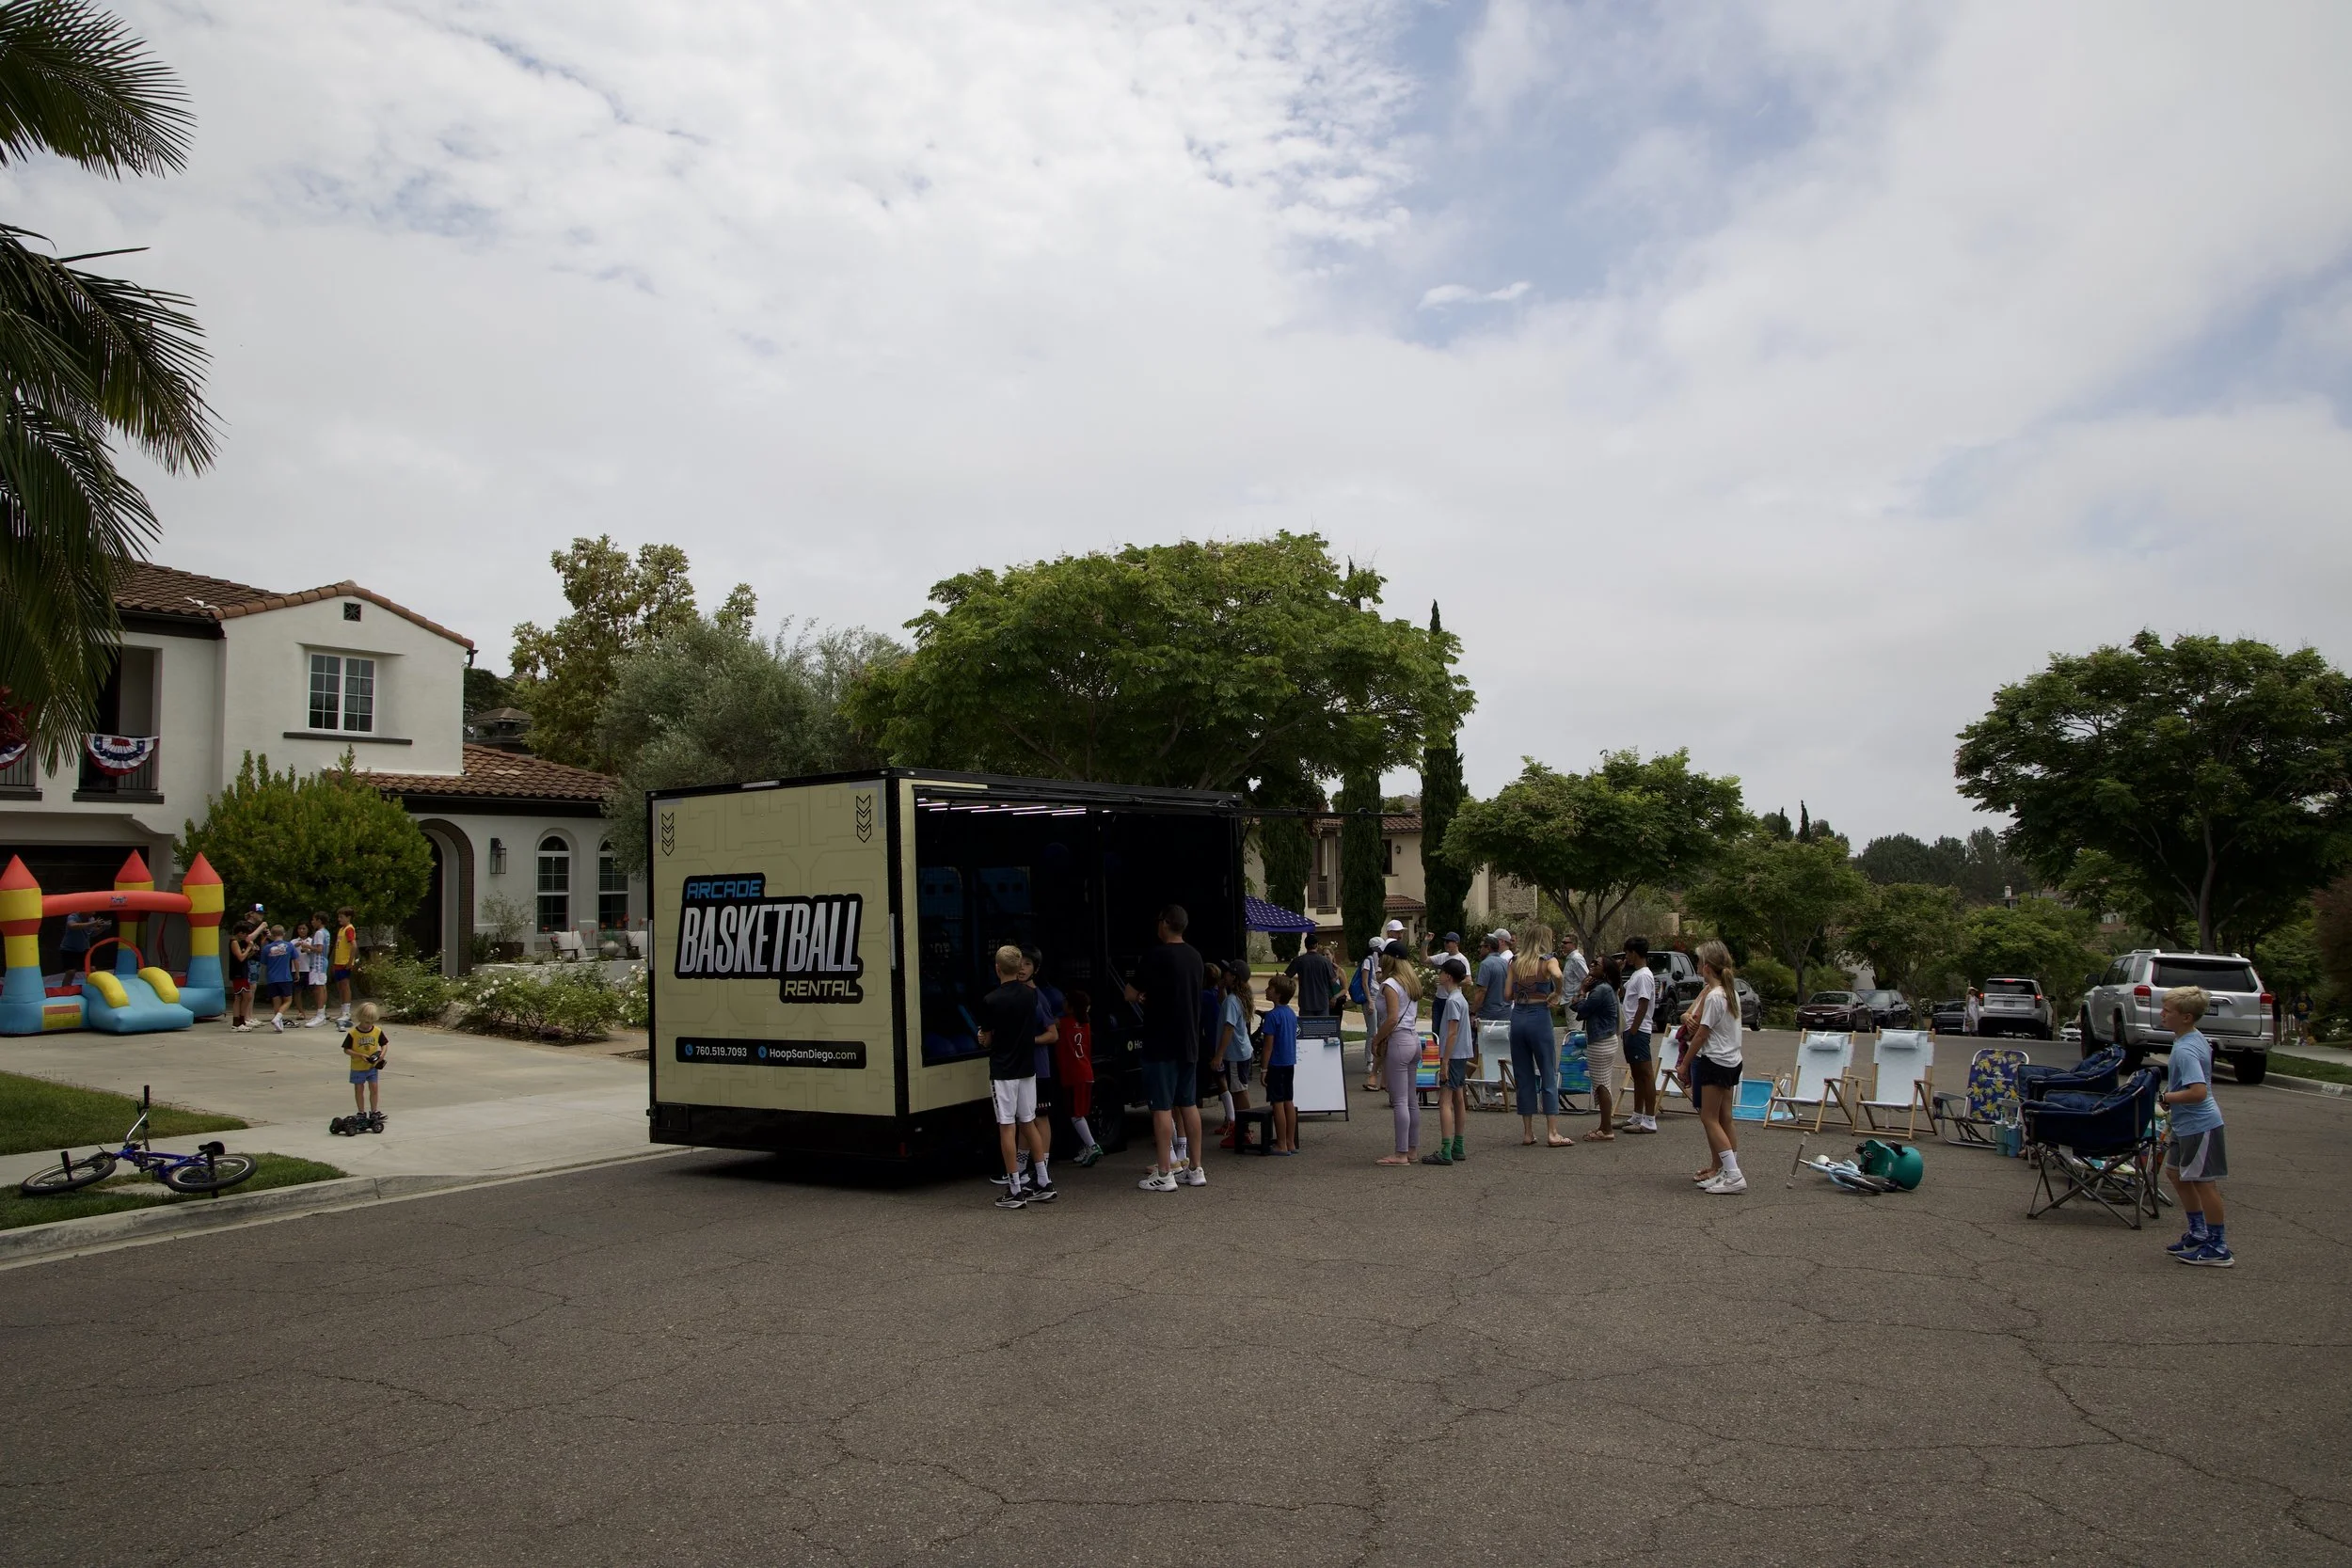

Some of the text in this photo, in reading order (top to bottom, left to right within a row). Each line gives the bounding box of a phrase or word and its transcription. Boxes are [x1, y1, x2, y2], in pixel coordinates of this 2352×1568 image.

[686, 879, 763, 900] ARCADE
[678, 901, 859, 974] BASKETBALL
[784, 979, 858, 997] RENTAL
[695, 1045, 857, 1063] 760.519.7093 HoopSanDiego.com
[1074, 1033, 1084, 1058] 3
